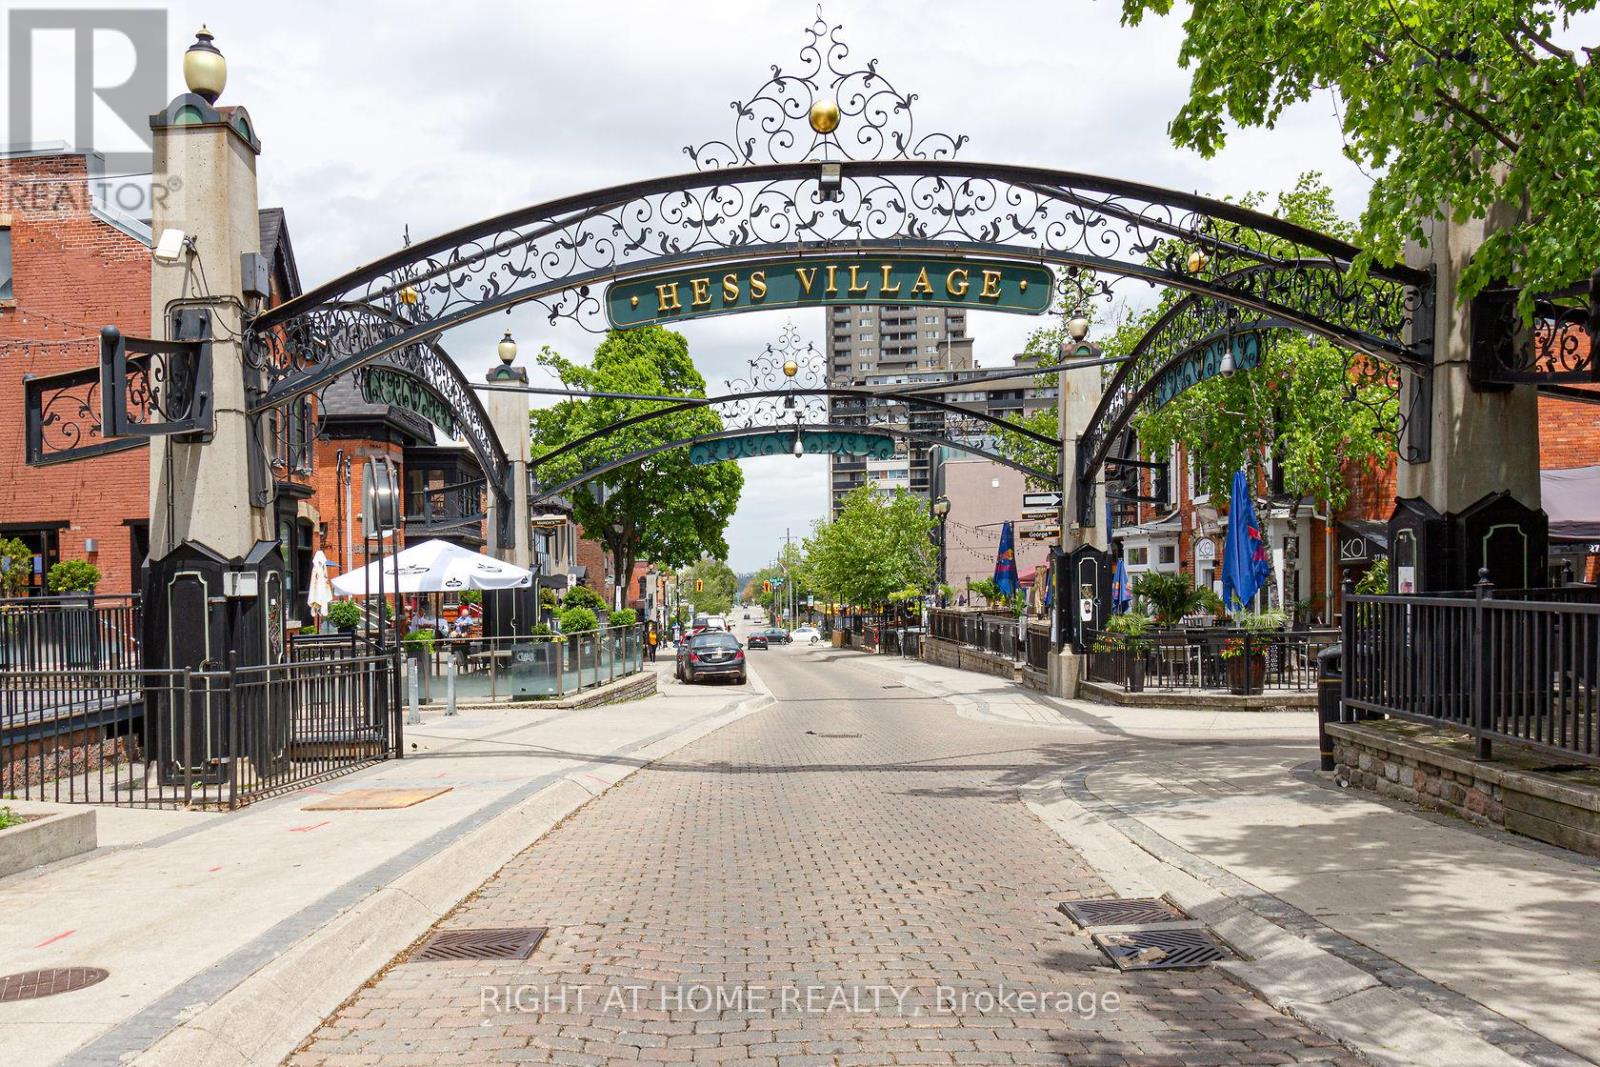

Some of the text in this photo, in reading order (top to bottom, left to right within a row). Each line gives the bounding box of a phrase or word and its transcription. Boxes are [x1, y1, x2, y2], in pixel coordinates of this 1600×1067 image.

[655, 264, 1002, 312] HESS VILLAGE
[1340, 537, 1367, 558] KOI
